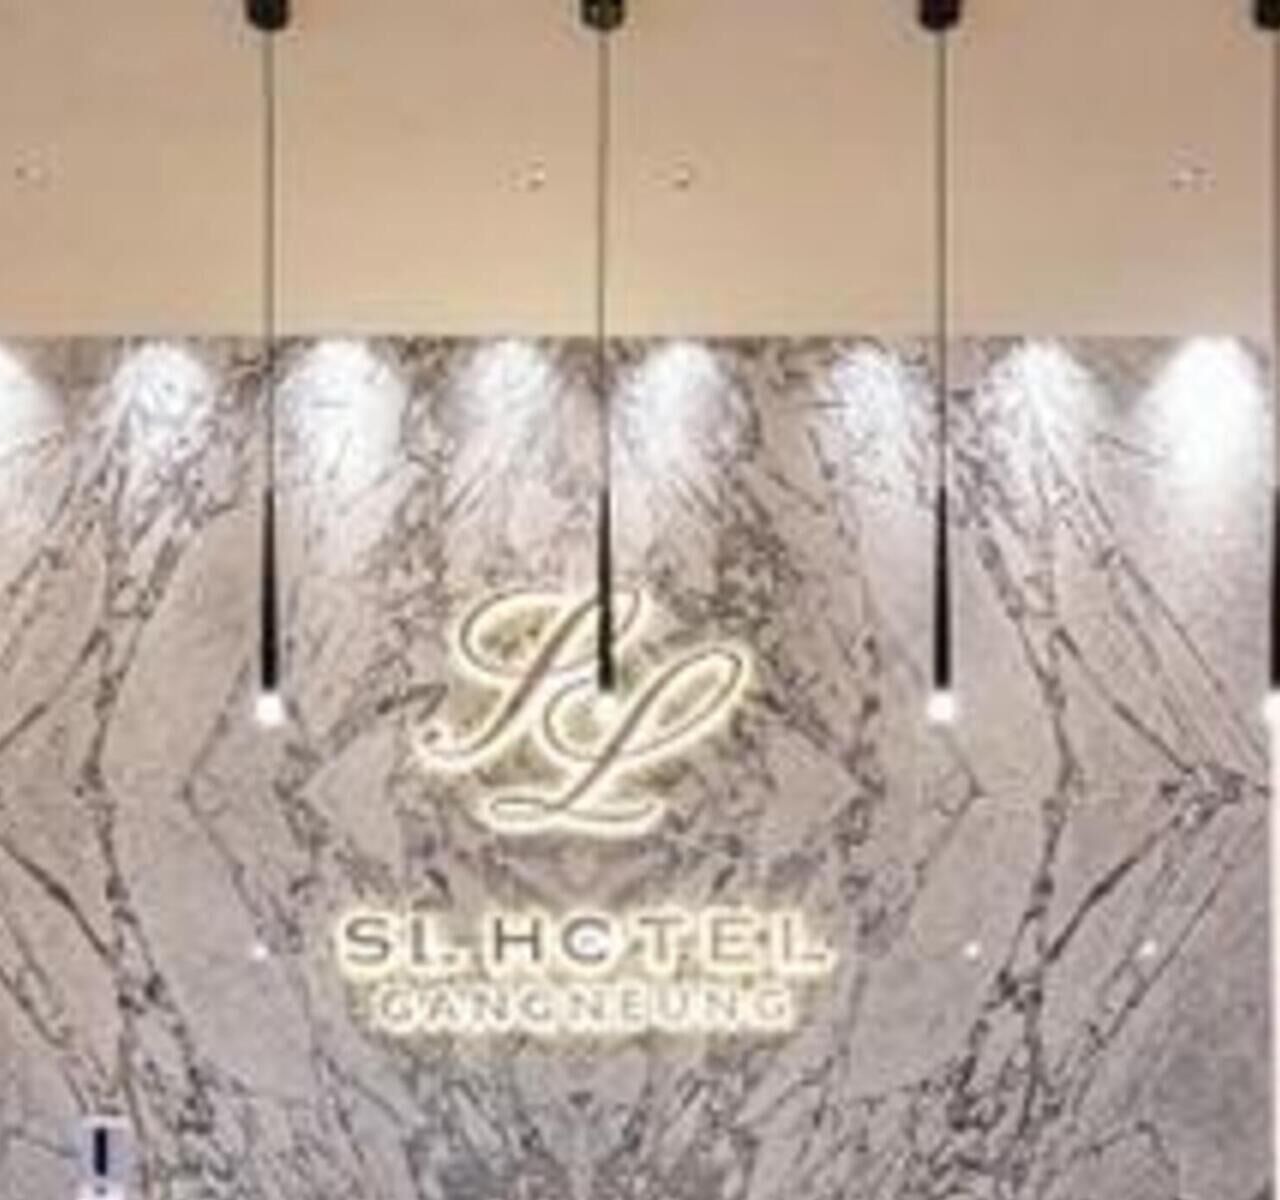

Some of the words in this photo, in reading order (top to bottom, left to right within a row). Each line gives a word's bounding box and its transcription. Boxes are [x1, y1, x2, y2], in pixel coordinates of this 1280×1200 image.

[341, 911, 460, 967] SL
[488, 911, 830, 968] HOTEL
[377, 983, 797, 1028] GANGNEUNG
